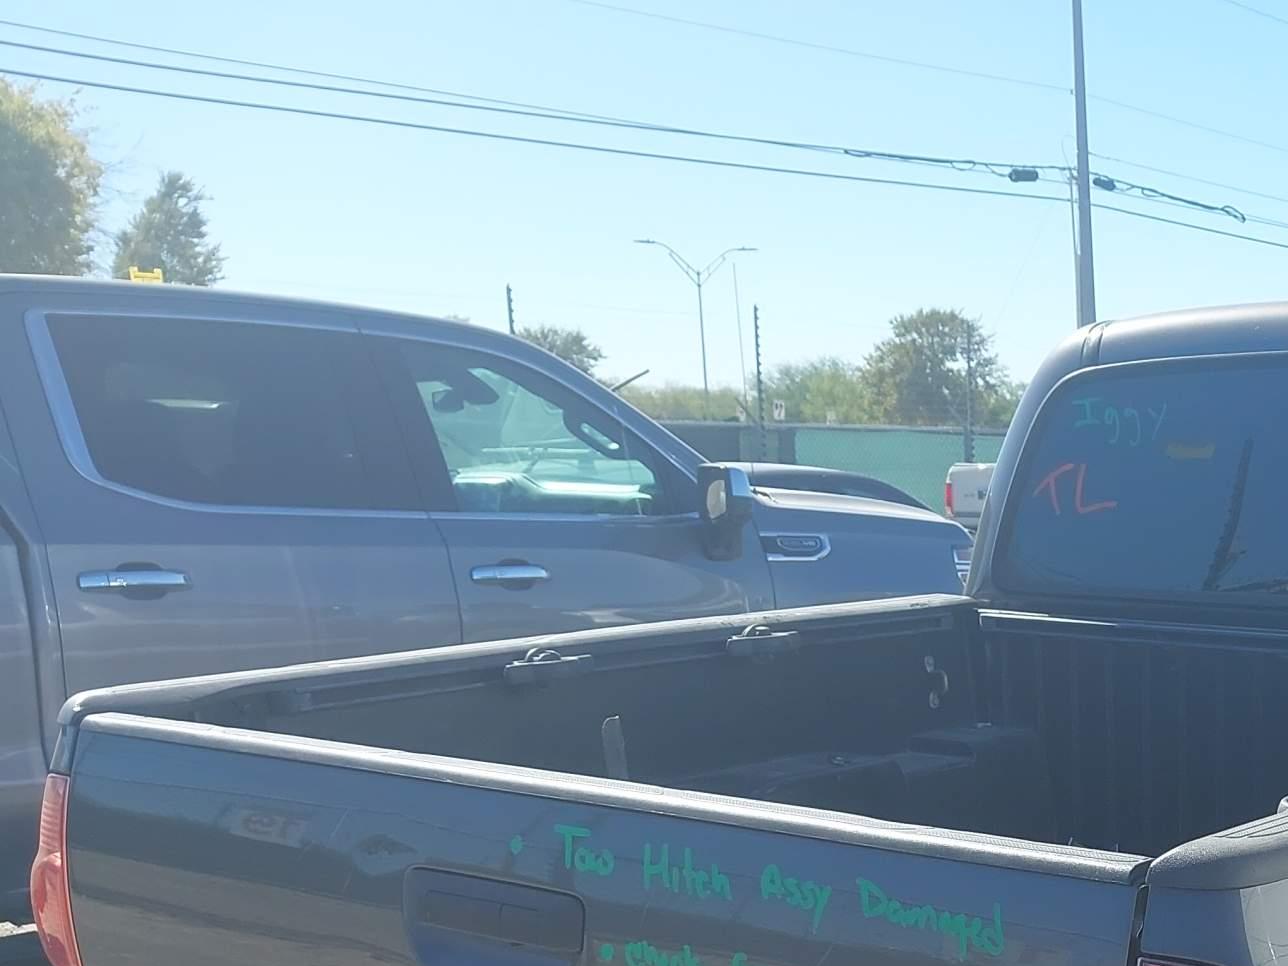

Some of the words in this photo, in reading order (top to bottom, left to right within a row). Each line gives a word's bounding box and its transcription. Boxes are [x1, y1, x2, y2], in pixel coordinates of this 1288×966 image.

[1033, 463, 1118, 514] TL
[554, 823, 615, 876] Tow
[641, 842, 734, 900] Hitch
[761, 864, 832, 935] Assy
